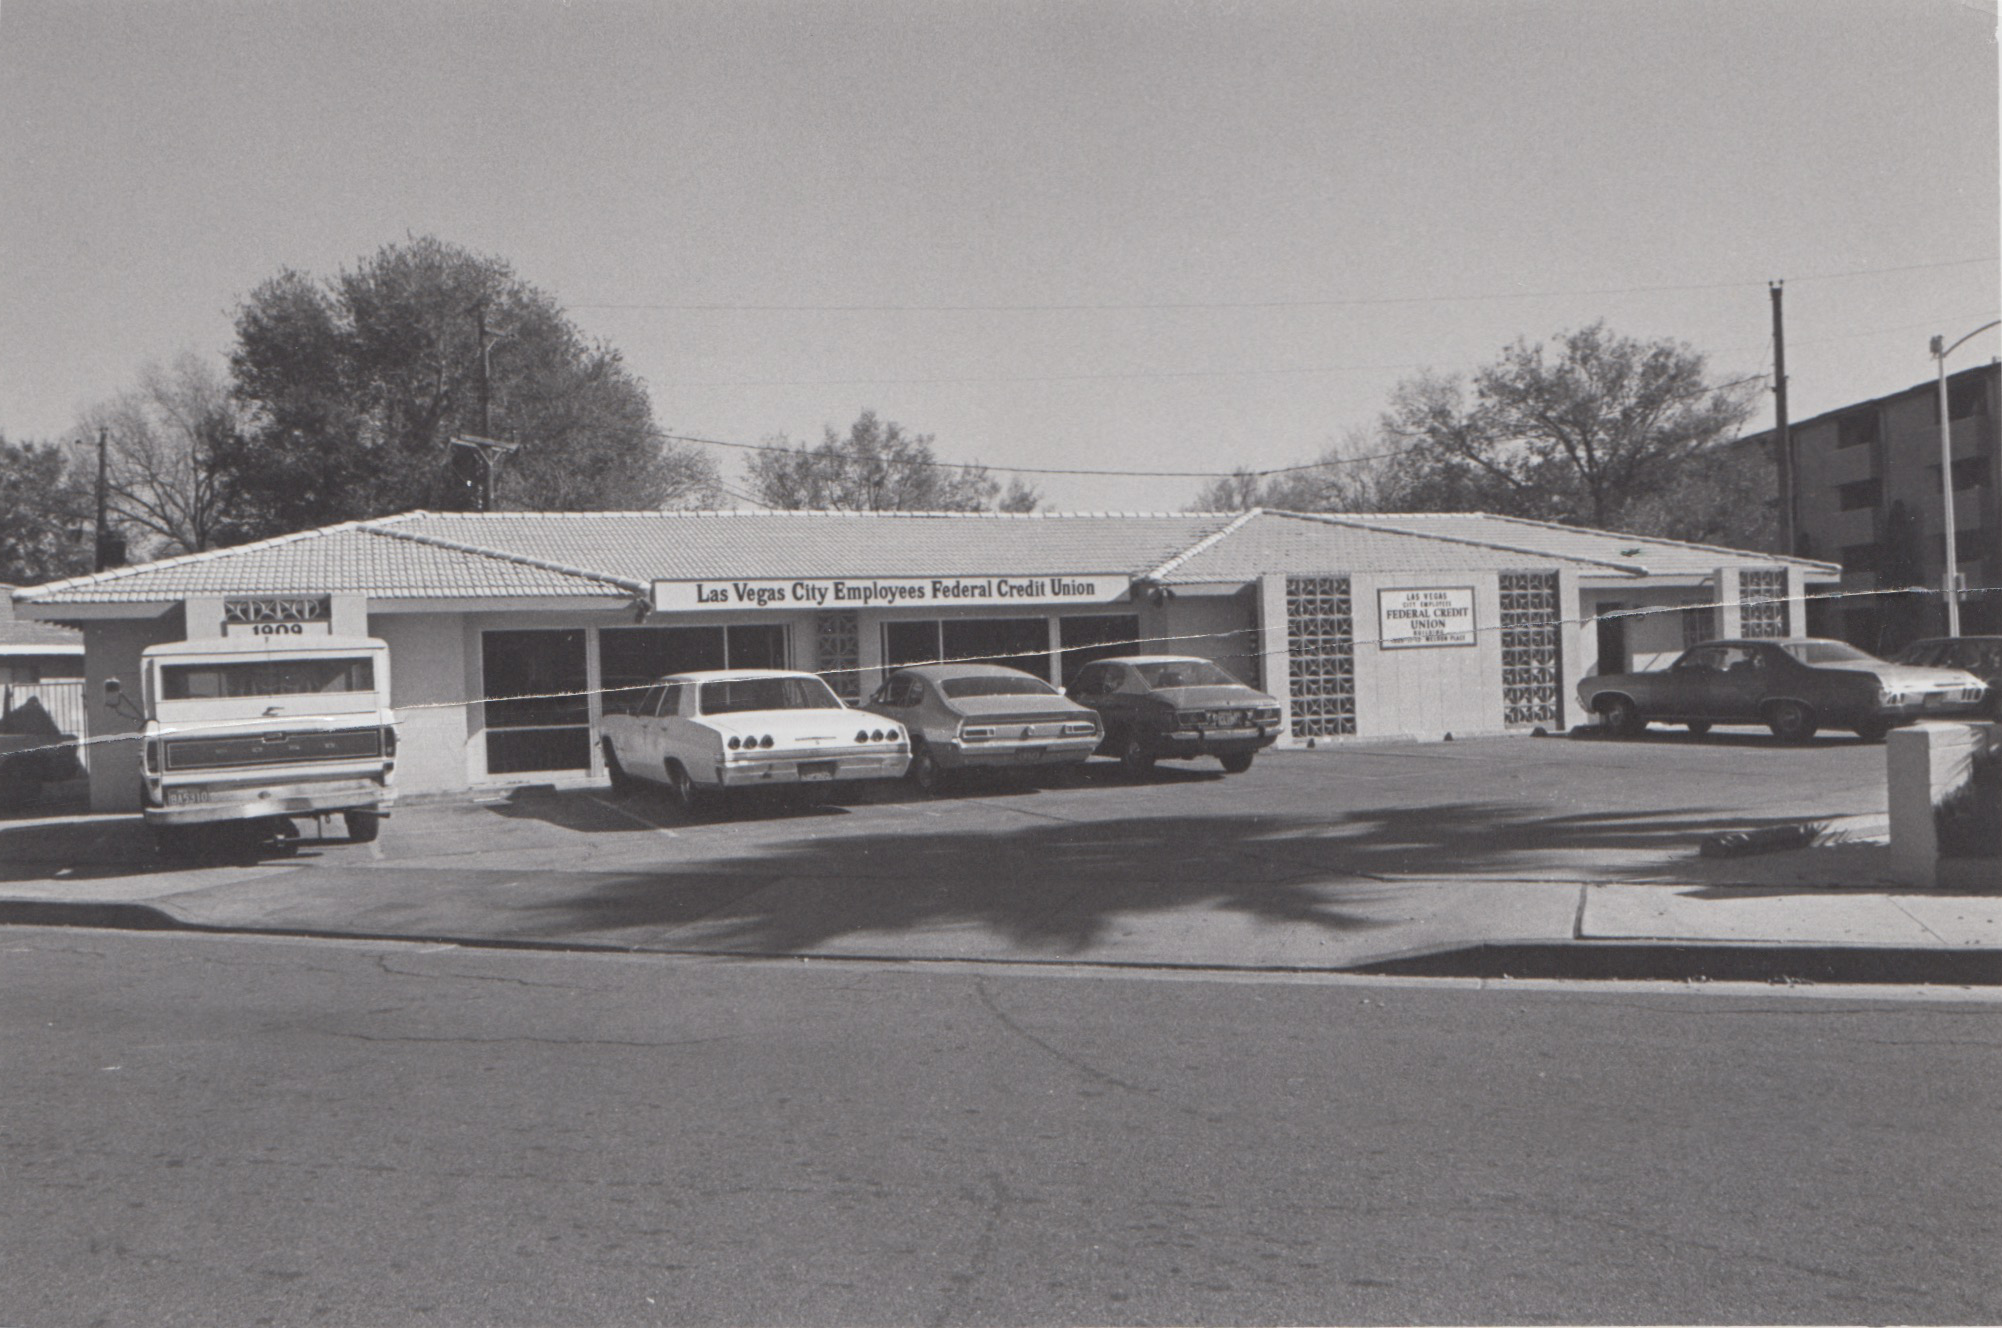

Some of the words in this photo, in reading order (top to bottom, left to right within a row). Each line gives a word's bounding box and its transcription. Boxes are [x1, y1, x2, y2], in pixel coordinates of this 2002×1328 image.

[696, 584, 729, 603] Las
[733, 582, 786, 606] Vegas
[791, 582, 829, 606] City
[833, 580, 926, 605] Employees
[931, 580, 993, 599] Federal
[997, 579, 1046, 598] Credit
[1051, 578, 1096, 597] Union
[1406, 593, 1420, 601] LAS
[1423, 591, 1448, 600] VEGAS
[1386, 608, 1431, 620] FEDERAL
[1433, 607, 1469, 618] CREDIT
[252, 624, 303, 635] 1909
[1410, 619, 1446, 630] UNION
